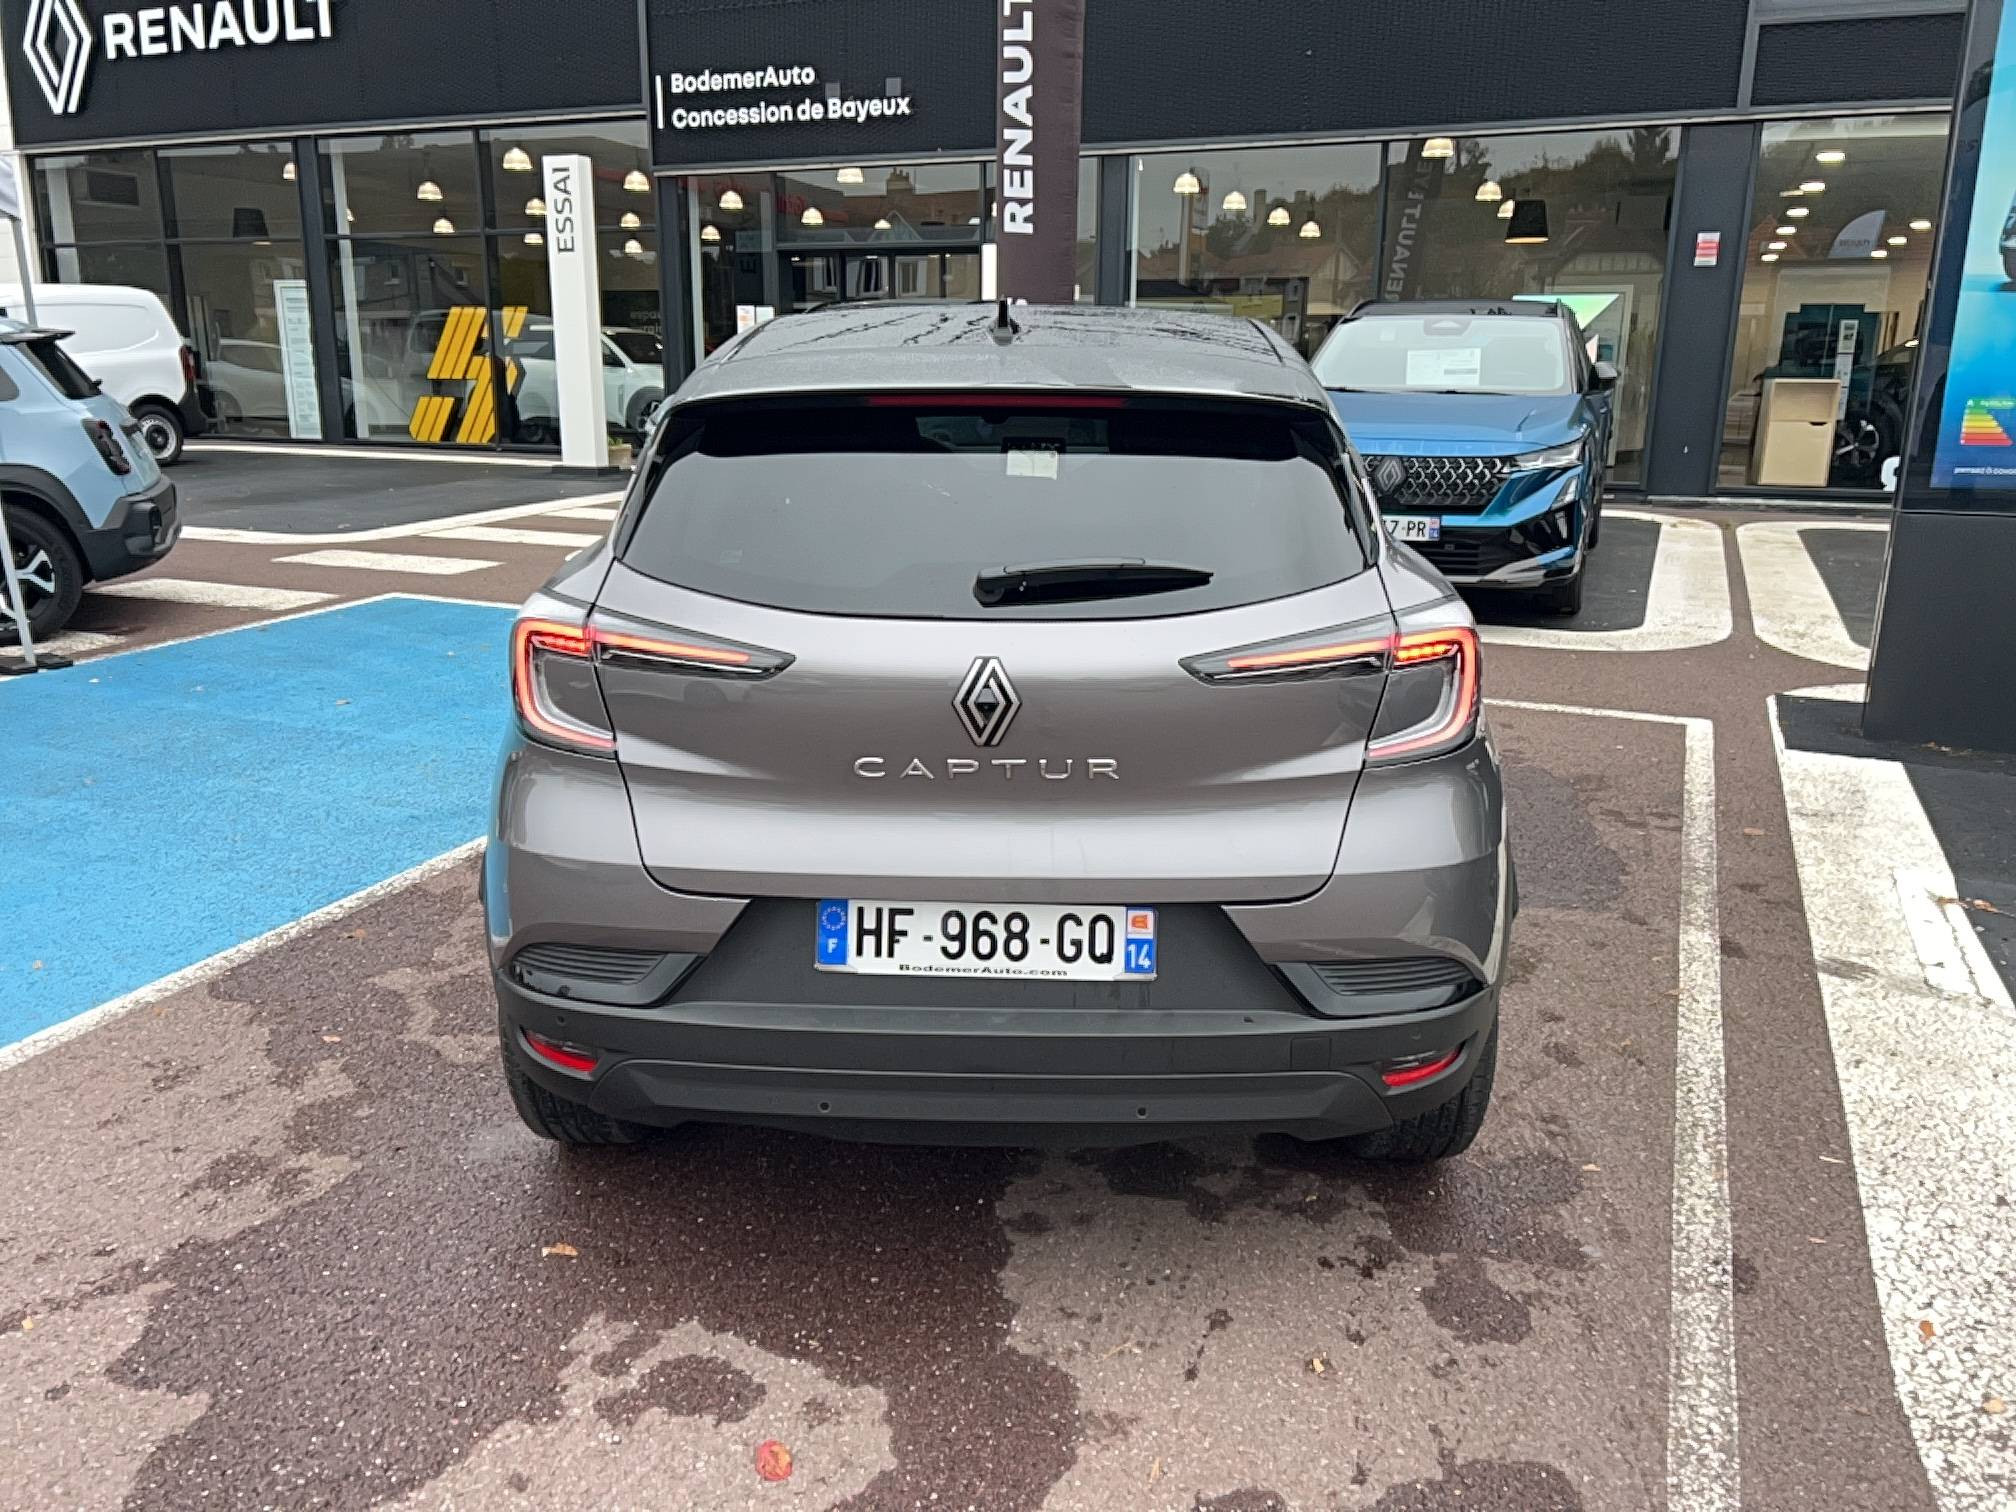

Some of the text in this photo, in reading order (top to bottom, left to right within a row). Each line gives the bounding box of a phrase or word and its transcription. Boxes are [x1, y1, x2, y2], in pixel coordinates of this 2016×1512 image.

[102, 0, 333, 60] RENAULT
[670, 66, 815, 93] BodemerAuto
[671, 96, 911, 128] Concession de Bayeux
[552, 166, 575, 254] ESSAI
[853, 757, 1120, 780] CAPTUR
[826, 938, 838, 953] F
[1127, 944, 1151, 969] 14
[898, 963, 1068, 977] BodemerAuto.com
